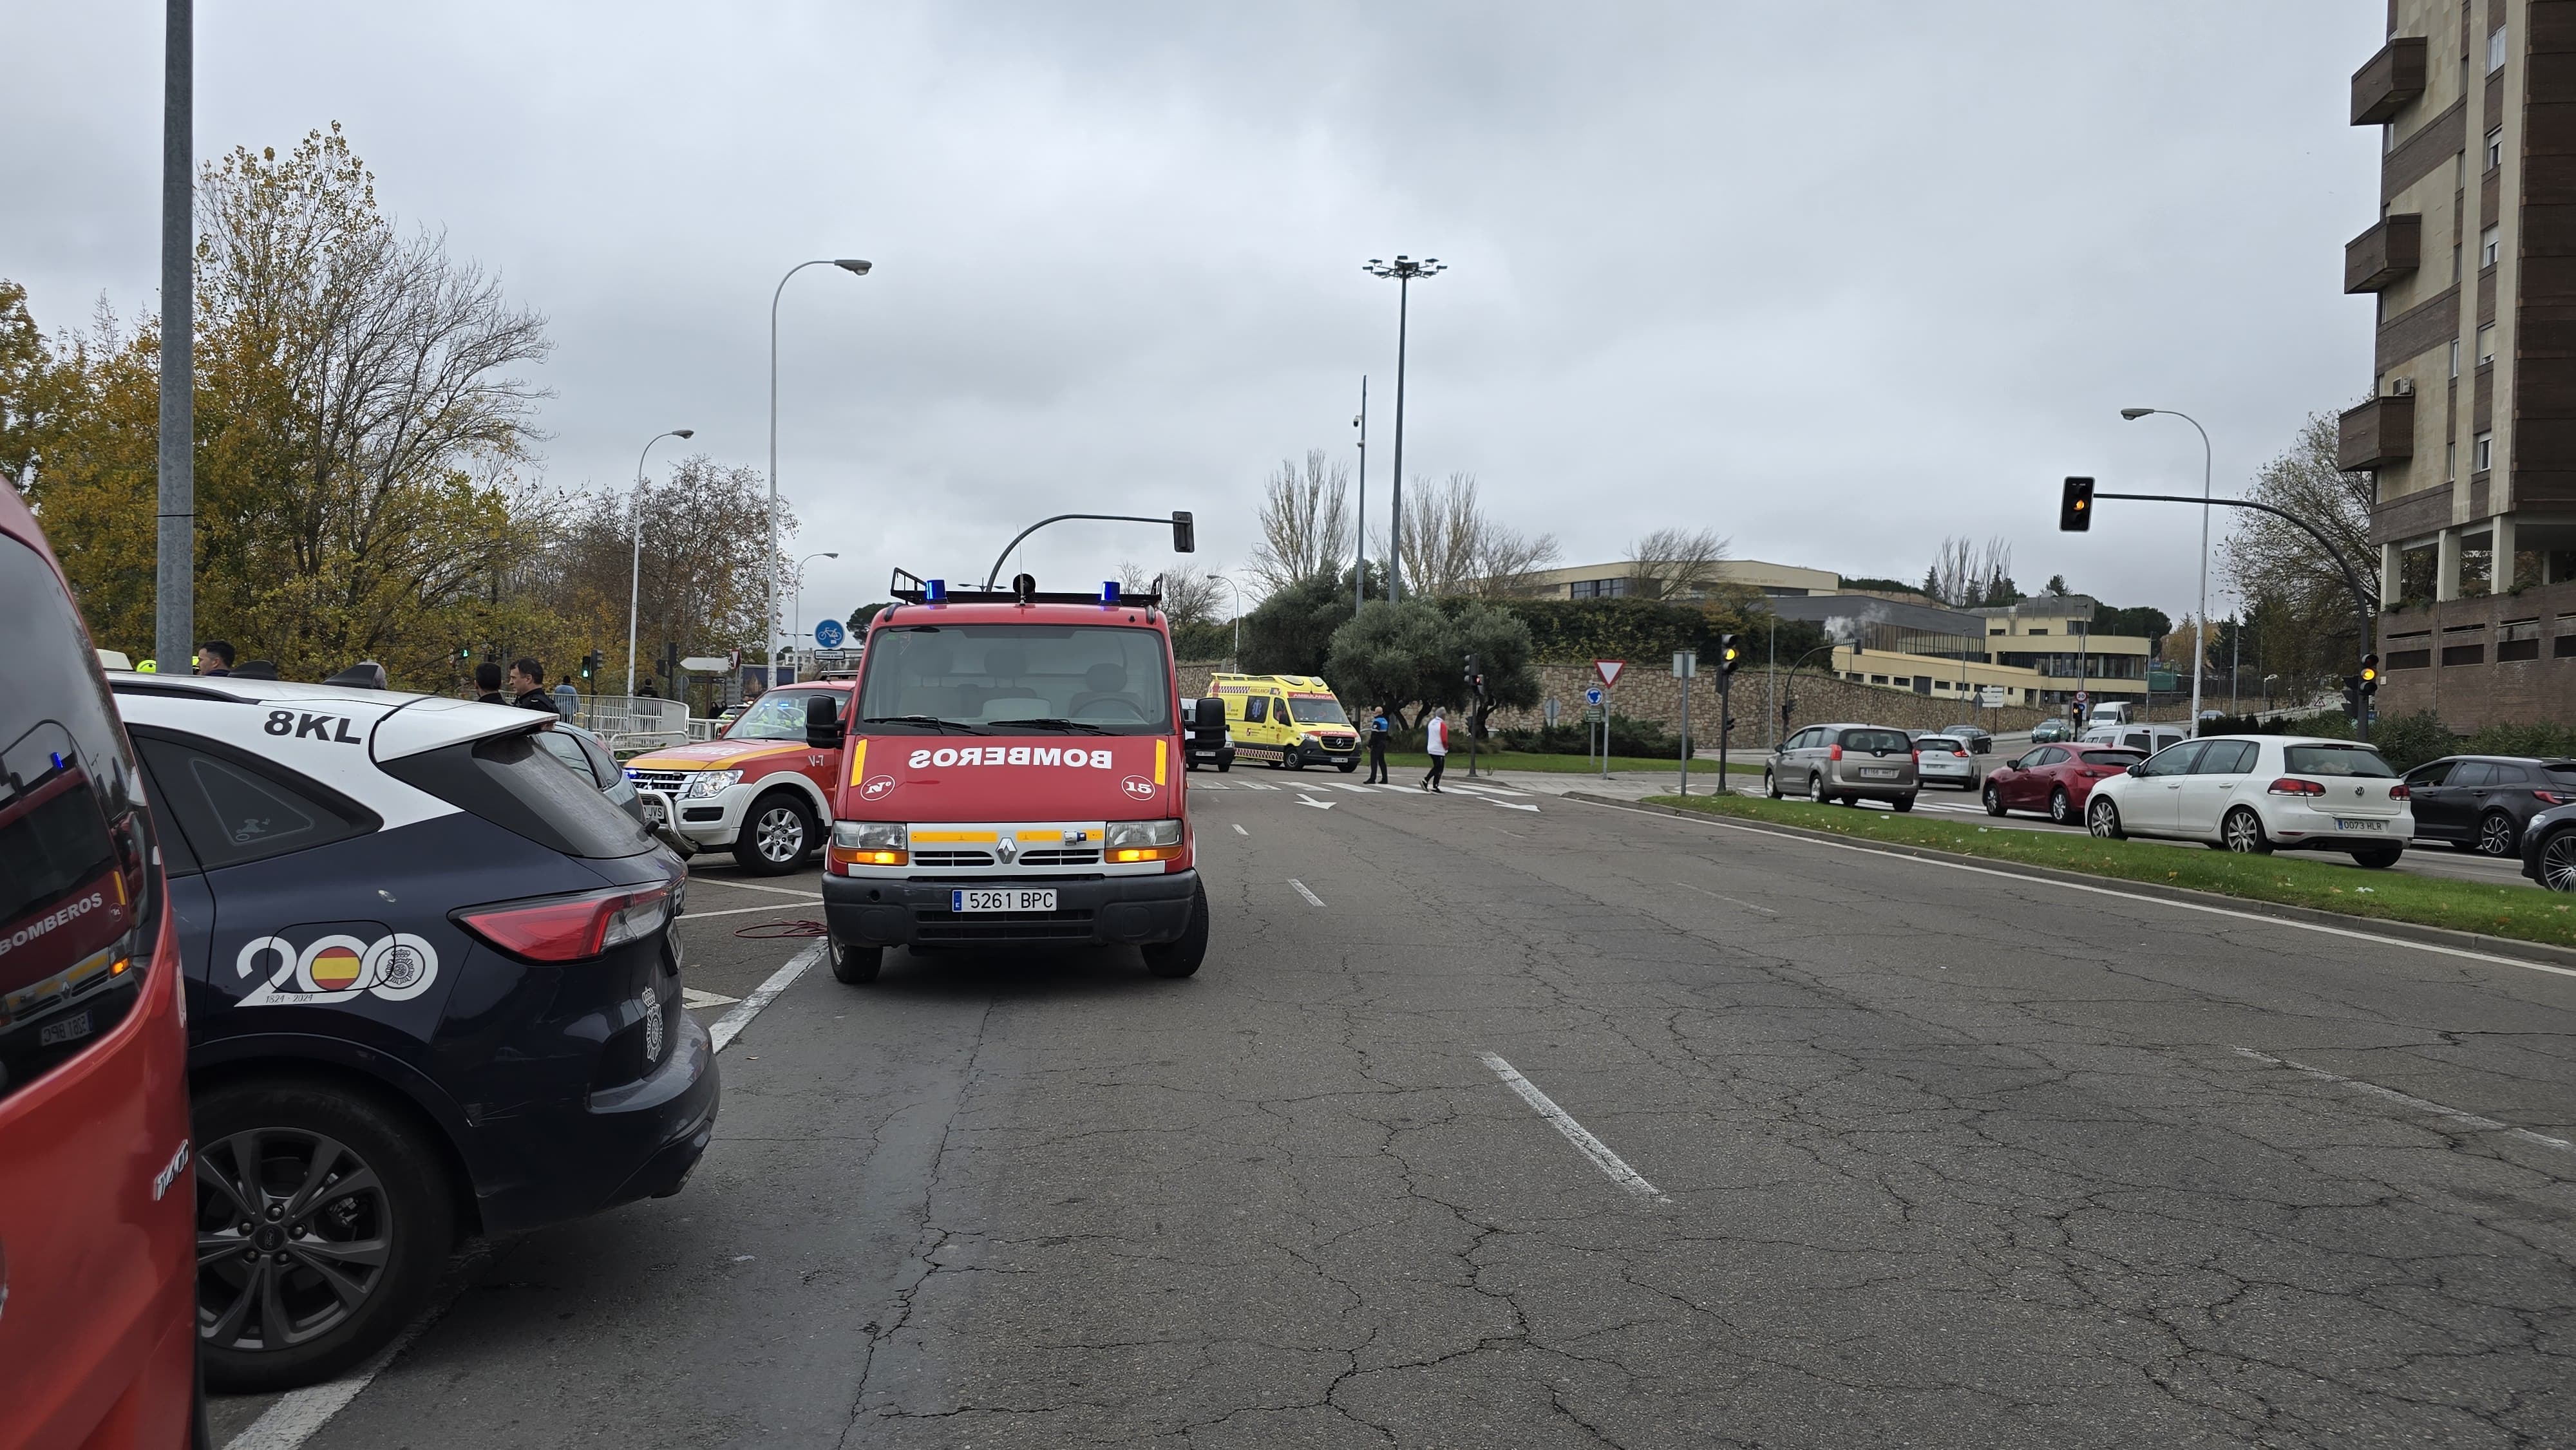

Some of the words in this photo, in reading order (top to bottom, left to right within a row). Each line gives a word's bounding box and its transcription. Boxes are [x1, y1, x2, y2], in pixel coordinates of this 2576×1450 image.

[264, 710, 361, 744] 8KL
[808, 755, 824, 767] V-7
[1125, 781, 1152, 793] 15
[649, 807, 663, 817] JVS
[2344, 821, 2365, 830] 0073
[2367, 822, 2382, 831] HLR
[970, 892, 1011, 909] 5261
[1021, 892, 1053, 909] BPC
[0, 892, 103, 956] BOMBEROS
[234, 933, 439, 1007] 200
